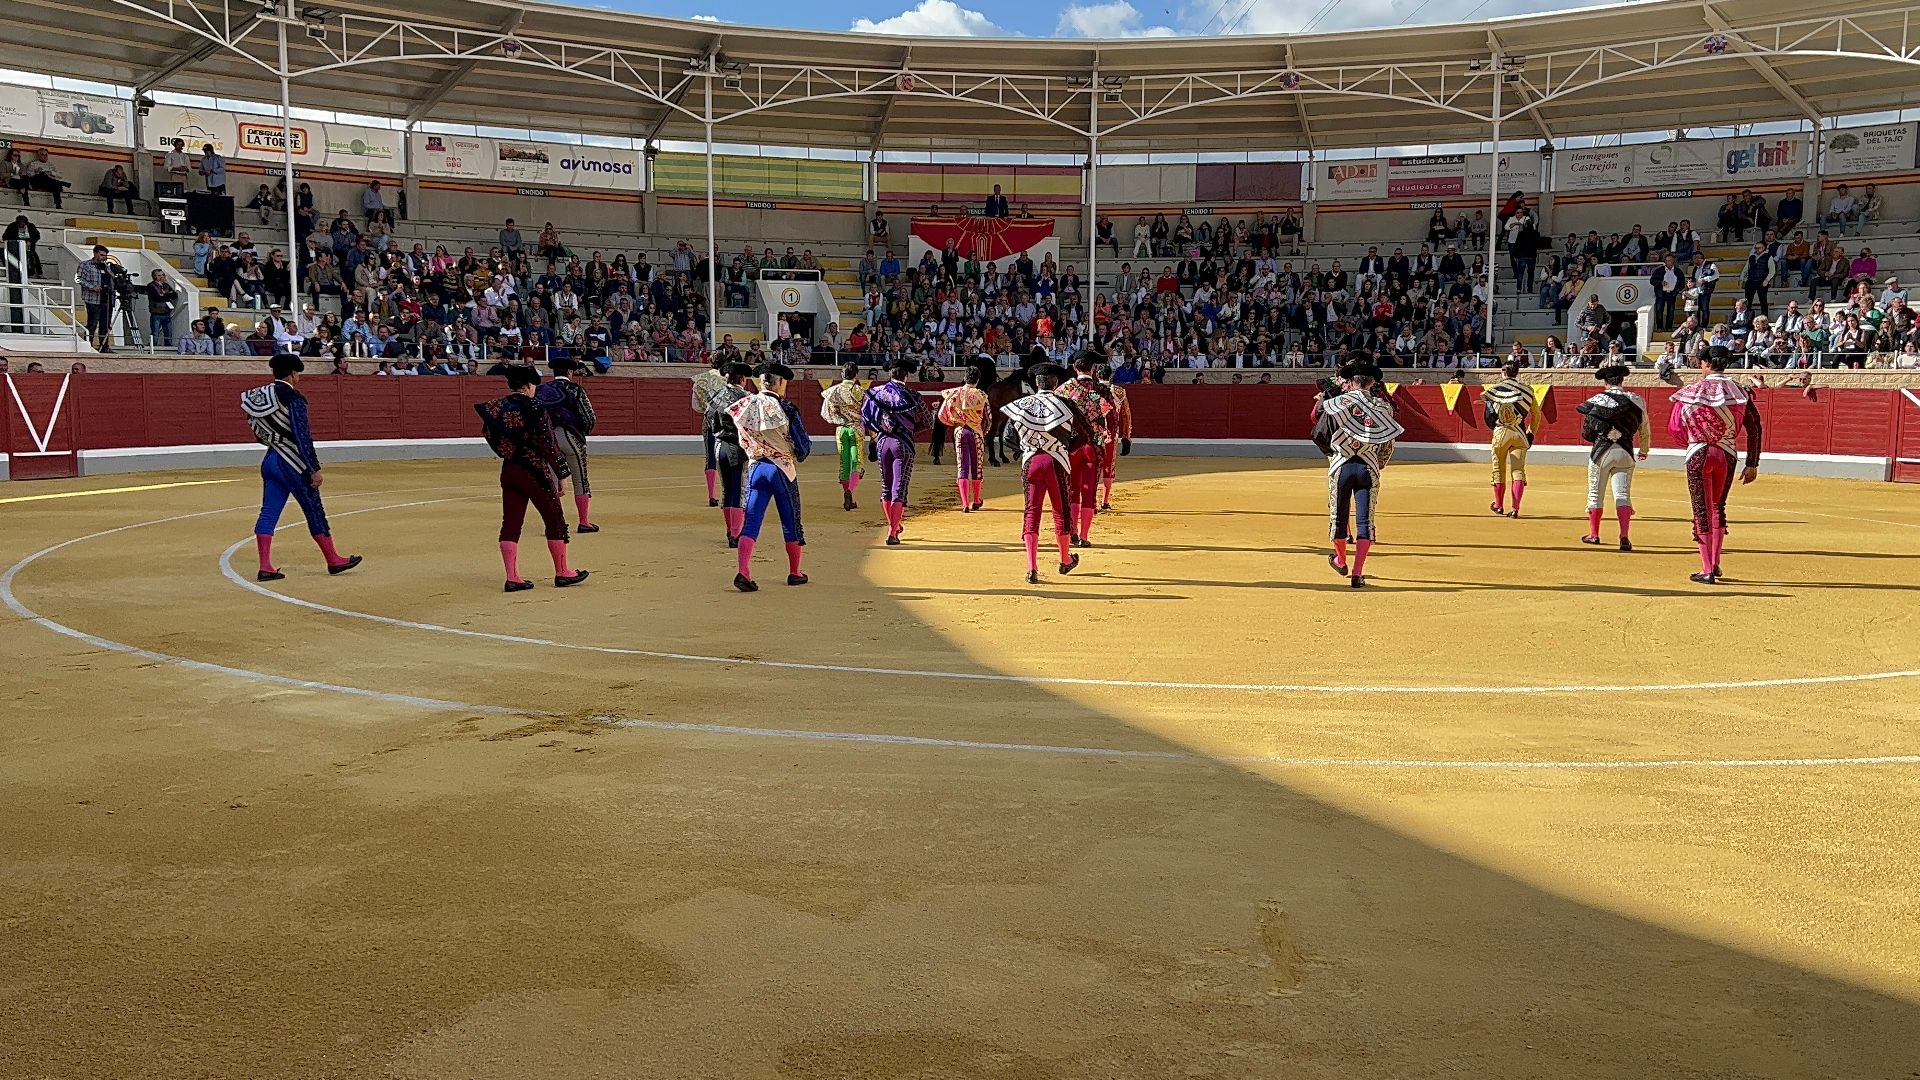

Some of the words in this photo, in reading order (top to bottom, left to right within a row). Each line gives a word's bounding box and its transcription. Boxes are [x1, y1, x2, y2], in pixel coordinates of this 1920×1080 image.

[247, 128, 300, 139] DESGUAES
[1863, 127, 1908, 138] BRIQUETAS
[247, 135, 262, 145] LA
[264, 137, 301, 149] TORE
[1884, 135, 1903, 143] TAJO
[1401, 157, 1435, 165] estudio
[1437, 156, 1462, 164] A.I.A.
[1570, 151, 1619, 162] Hormigones
[1726, 143, 1756, 174] get
[559, 156, 632, 175] avimosa
[1570, 160, 1618, 173] Castrejón
[517, 188, 544, 196] TENDIDO
[1390, 183, 1461, 192] estudioaia.com
[1657, 190, 1687, 198] TENDIDO
[746, 201, 772, 209] TENDIDO
[1410, 202, 1437, 210] TENDIDO
[788, 292, 793, 302] 1
[1624, 288, 1631, 299] 8
